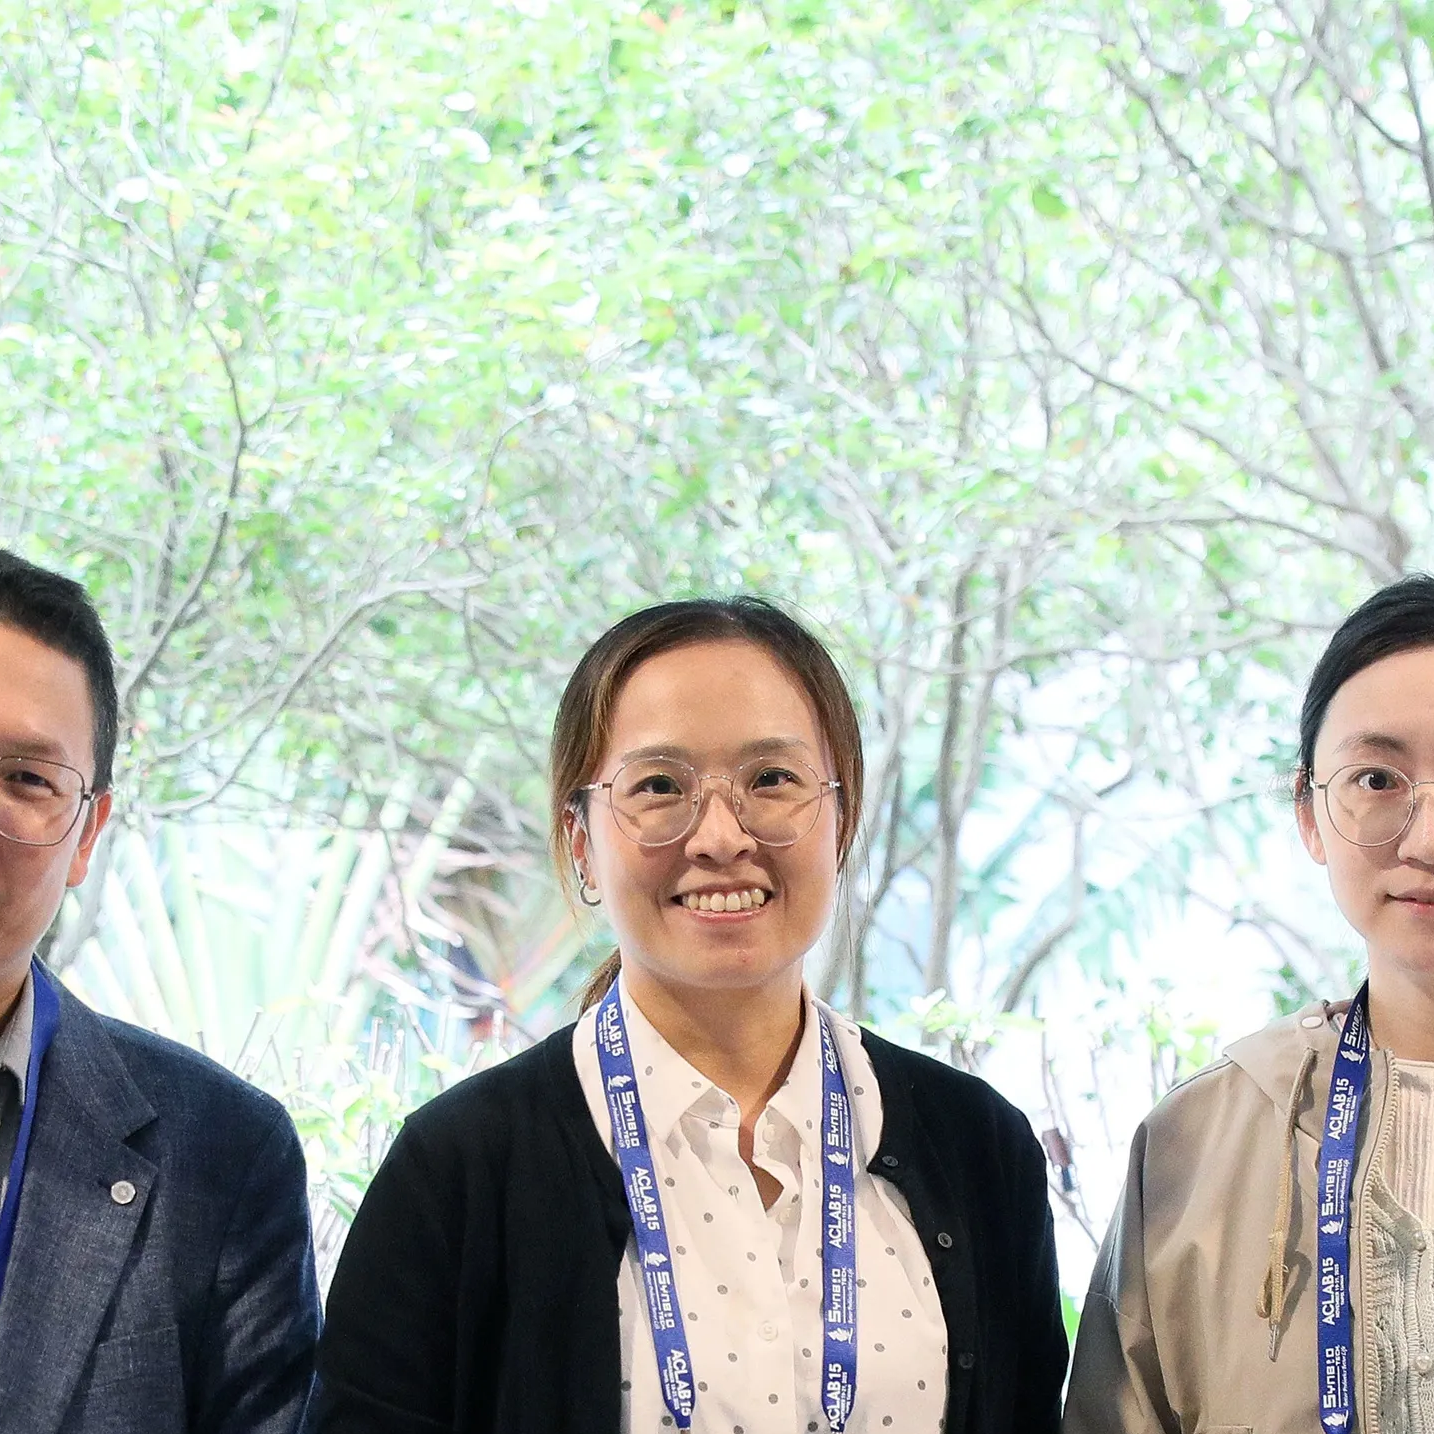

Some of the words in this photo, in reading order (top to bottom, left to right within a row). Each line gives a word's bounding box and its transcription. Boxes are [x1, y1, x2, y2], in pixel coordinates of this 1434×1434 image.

[603, 1002, 622, 1042] ACLAB
[610, 1041, 624, 1056] 15
[1335, 1077, 1349, 1092] 15
[1327, 1093, 1349, 1140] ACLAB
[635, 1166, 657, 1215] ACLAB
[646, 1215, 660, 1230] 15
[829, 1184, 840, 1198] 15
[829, 1201, 841, 1247] ACLAB
[1322, 1257, 1333, 1272] 15
[1321, 1274, 1336, 1325] ACLAB
[671, 1348, 691, 1399] ACLAB
[828, 1363, 841, 1378] 15
[680, 1400, 692, 1416] 15
[826, 1380, 840, 1429] ACLAB
